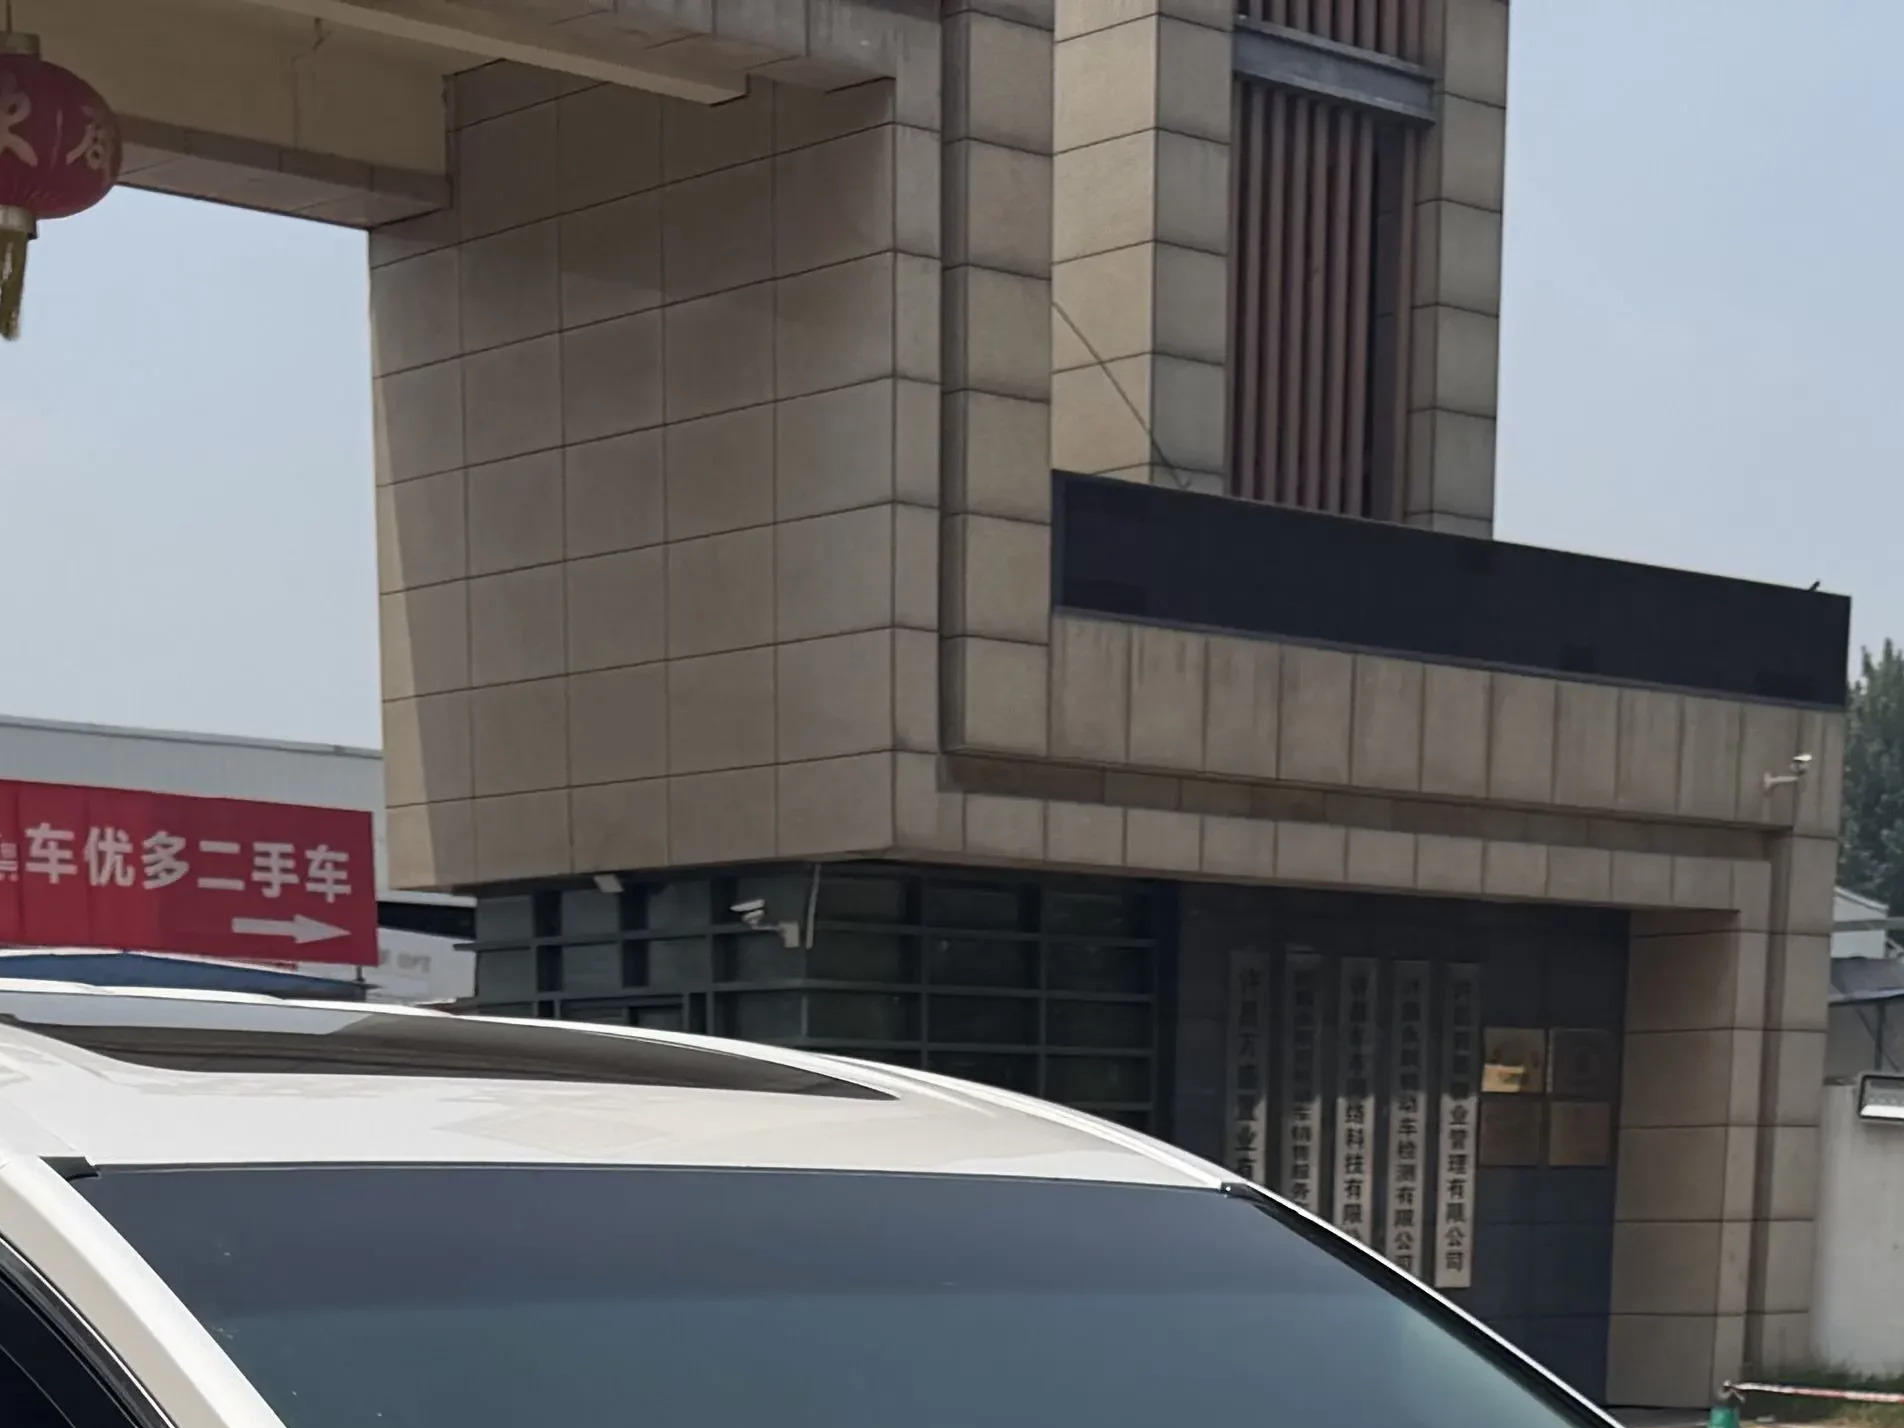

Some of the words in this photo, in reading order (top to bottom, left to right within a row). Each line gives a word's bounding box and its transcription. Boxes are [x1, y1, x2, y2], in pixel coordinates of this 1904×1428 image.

[25, 821, 352, 904] 车优多二手车
